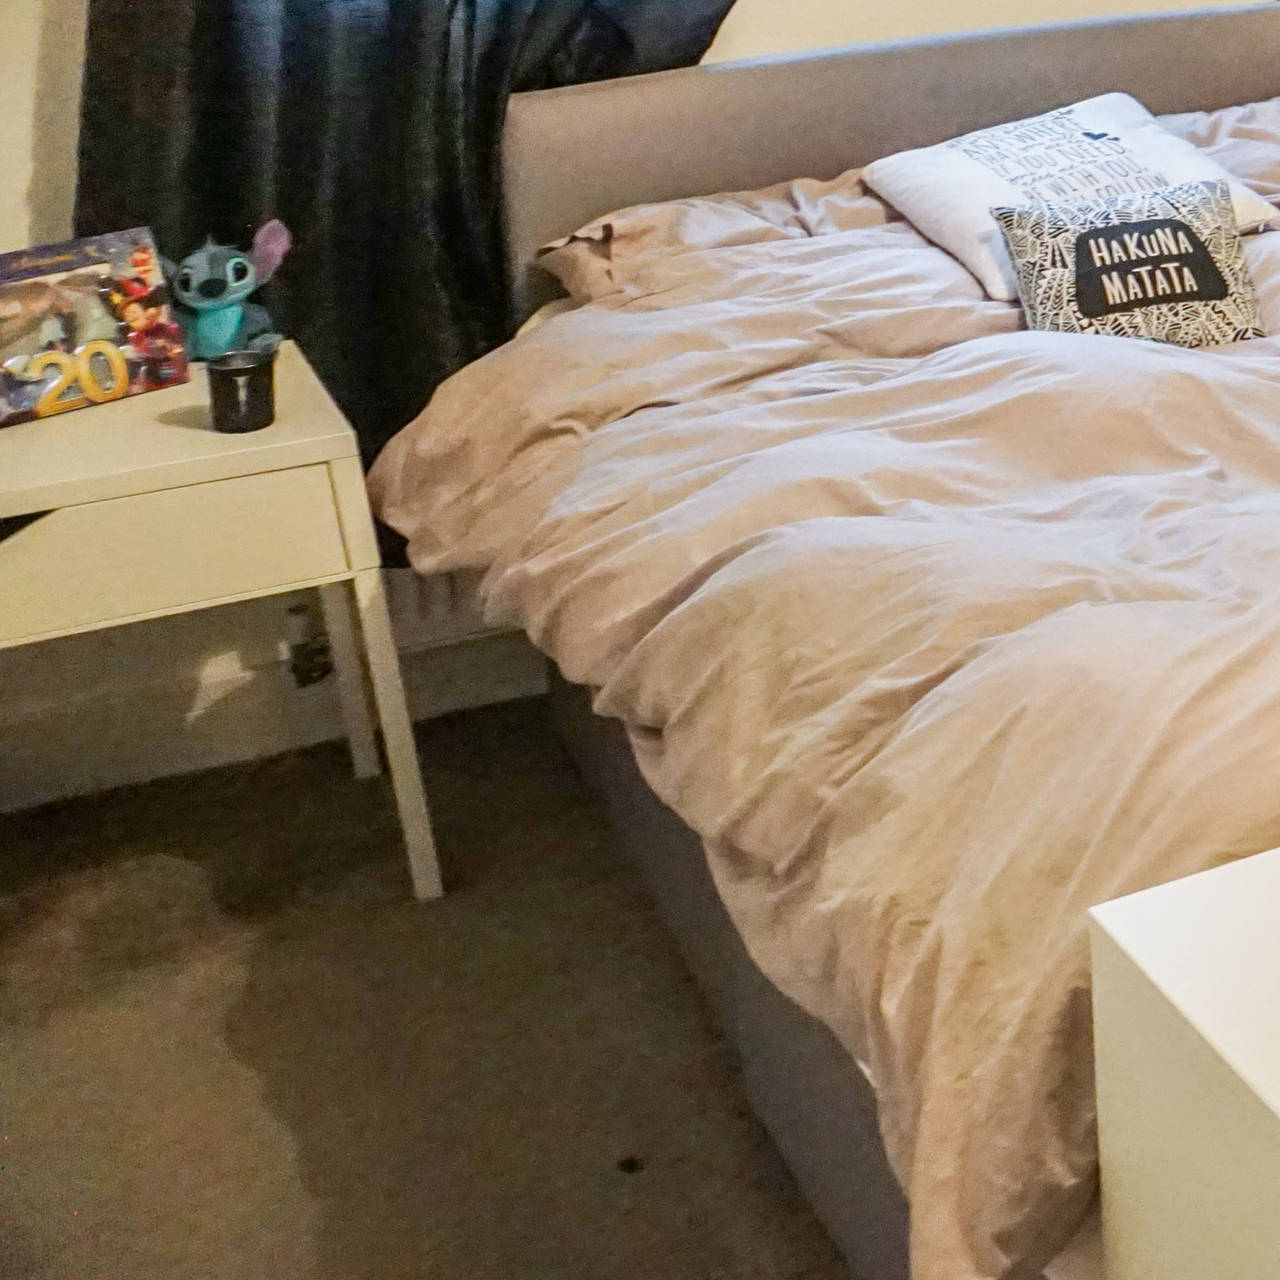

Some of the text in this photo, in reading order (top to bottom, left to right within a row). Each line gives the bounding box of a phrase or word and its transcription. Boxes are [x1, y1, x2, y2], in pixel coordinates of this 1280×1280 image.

[1013, 151, 1058, 170] YOU
[1045, 168, 1101, 197] WITH
[1088, 227, 1194, 267] HAKUNA
[1101, 262, 1198, 305] MATATA
